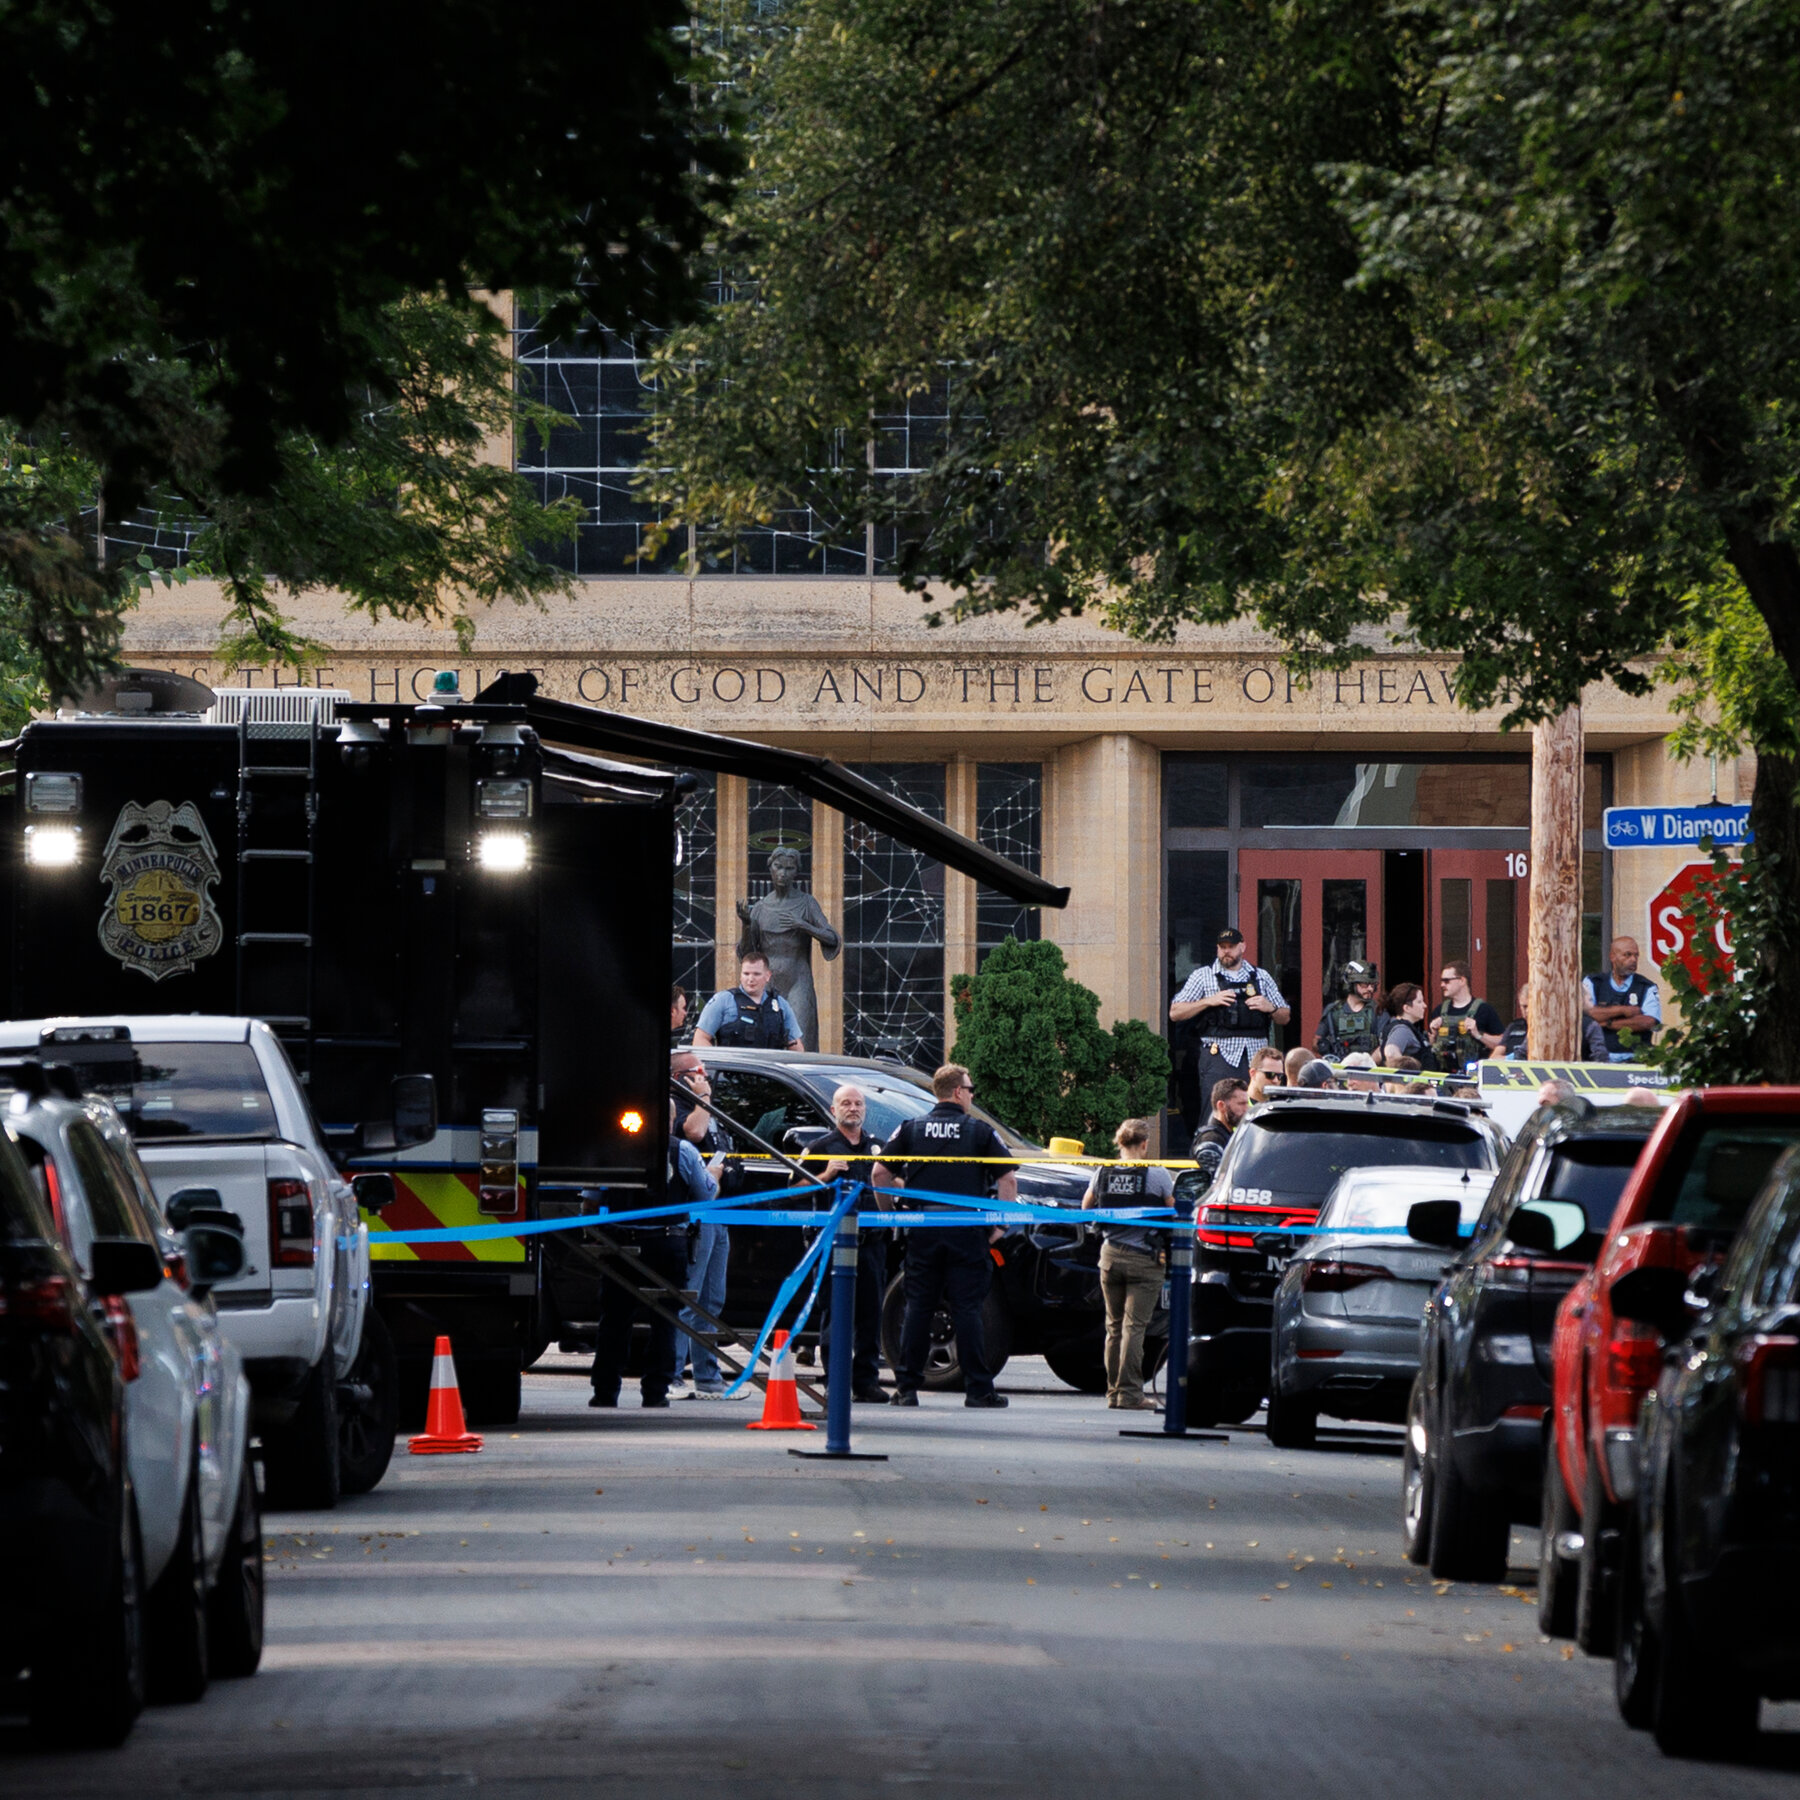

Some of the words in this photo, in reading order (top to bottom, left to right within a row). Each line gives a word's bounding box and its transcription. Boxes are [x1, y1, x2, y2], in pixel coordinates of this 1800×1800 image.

[577, 667, 639, 703] OF
[670, 667, 786, 704] GOD
[812, 668, 926, 703] AND
[953, 668, 1054, 703] THE
[1081, 667, 1215, 703] GATE
[1641, 815, 1657, 839] W
[1663, 812, 1749, 839] Diamond
[116, 853, 201, 879] MINNEAPOLIS
[1505, 853, 1528, 878] 16
[124, 891, 162, 905] Serving
[128, 903, 190, 922] 1867
[119, 938, 196, 961] POLICE
[925, 1122, 960, 1139] POLICE
[1109, 1183, 1135, 1193] POLICE
[1113, 1175, 1132, 1184] ATF
[1232, 1187, 1273, 1206] 958
